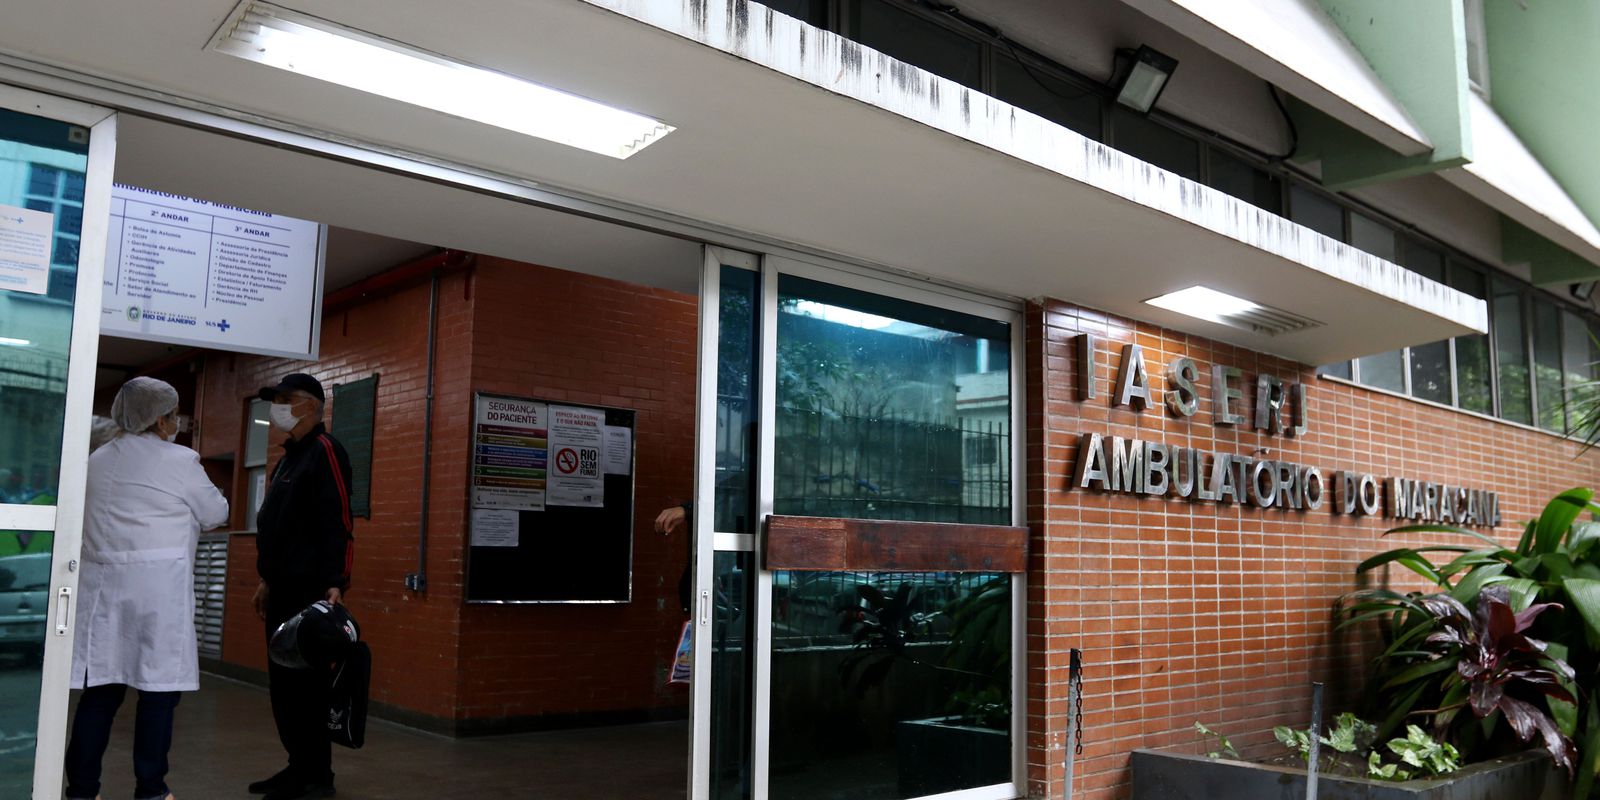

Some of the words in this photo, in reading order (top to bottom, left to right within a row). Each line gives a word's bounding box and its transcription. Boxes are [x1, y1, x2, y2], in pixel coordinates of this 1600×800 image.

[161, 212, 189, 222] ANDAR
[244, 227, 270, 238] ANDAR
[220, 241, 249, 251] Assessoria
[220, 249, 249, 258] Assessoria
[218, 262, 256, 273] Departamento
[244, 295, 264, 303] Pessoal
[168, 316, 196, 326] JANEIRO
[1077, 333, 1308, 436] IASERJ
[488, 402, 536, 415] SEGURANÇA
[488, 412, 499, 421] DO
[500, 413, 537, 425] PACIENTE
[580, 449, 597, 461] RIO
[580, 461, 597, 469] SEM
[580, 469, 597, 477] FUMO
[1075, 432, 1325, 511] AMBULATÓRIO
[1335, 470, 1379, 515] DO
